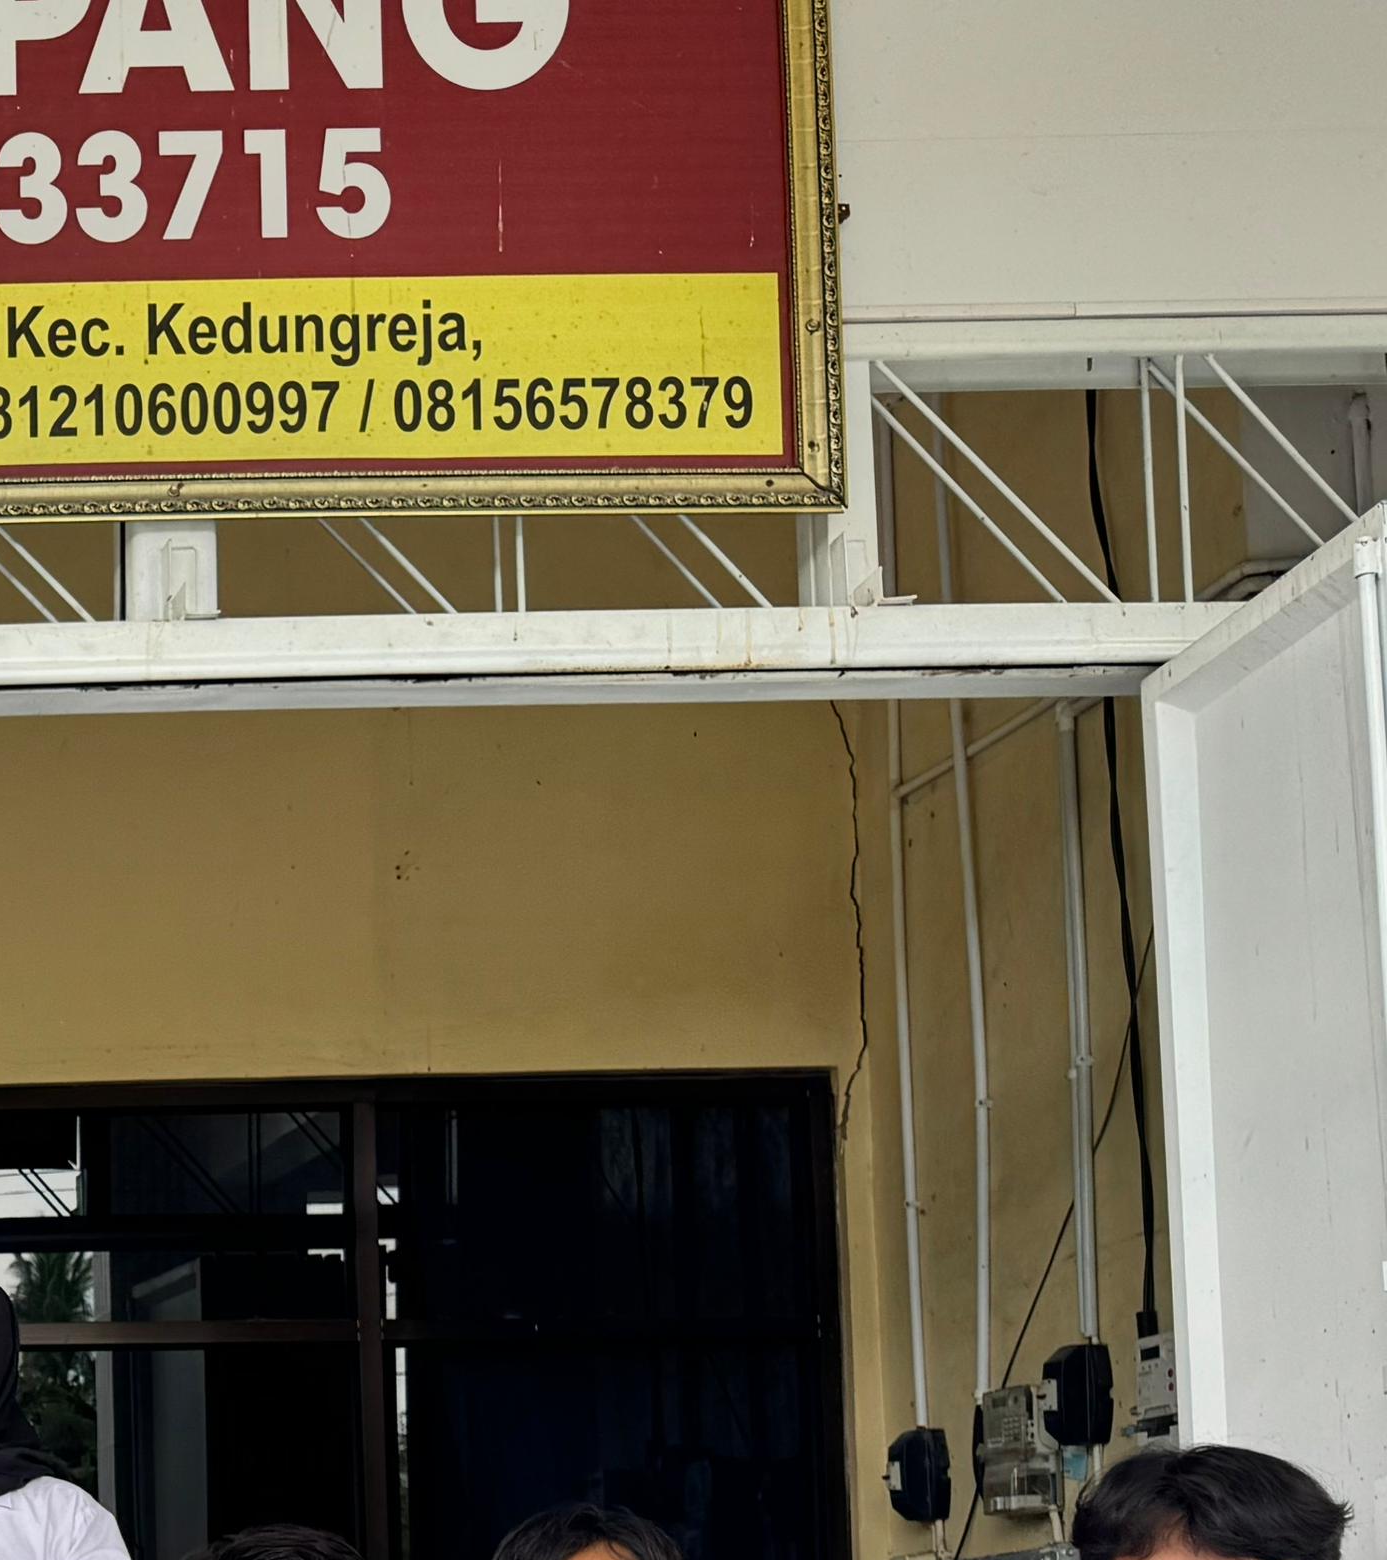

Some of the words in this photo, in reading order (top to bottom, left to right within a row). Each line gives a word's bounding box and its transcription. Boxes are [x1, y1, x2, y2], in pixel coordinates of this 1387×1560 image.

[8, 306, 124, 357] Kec.
[148, 300, 482, 366] Kedungreja,
[394, 376, 753, 432] 08156578379
